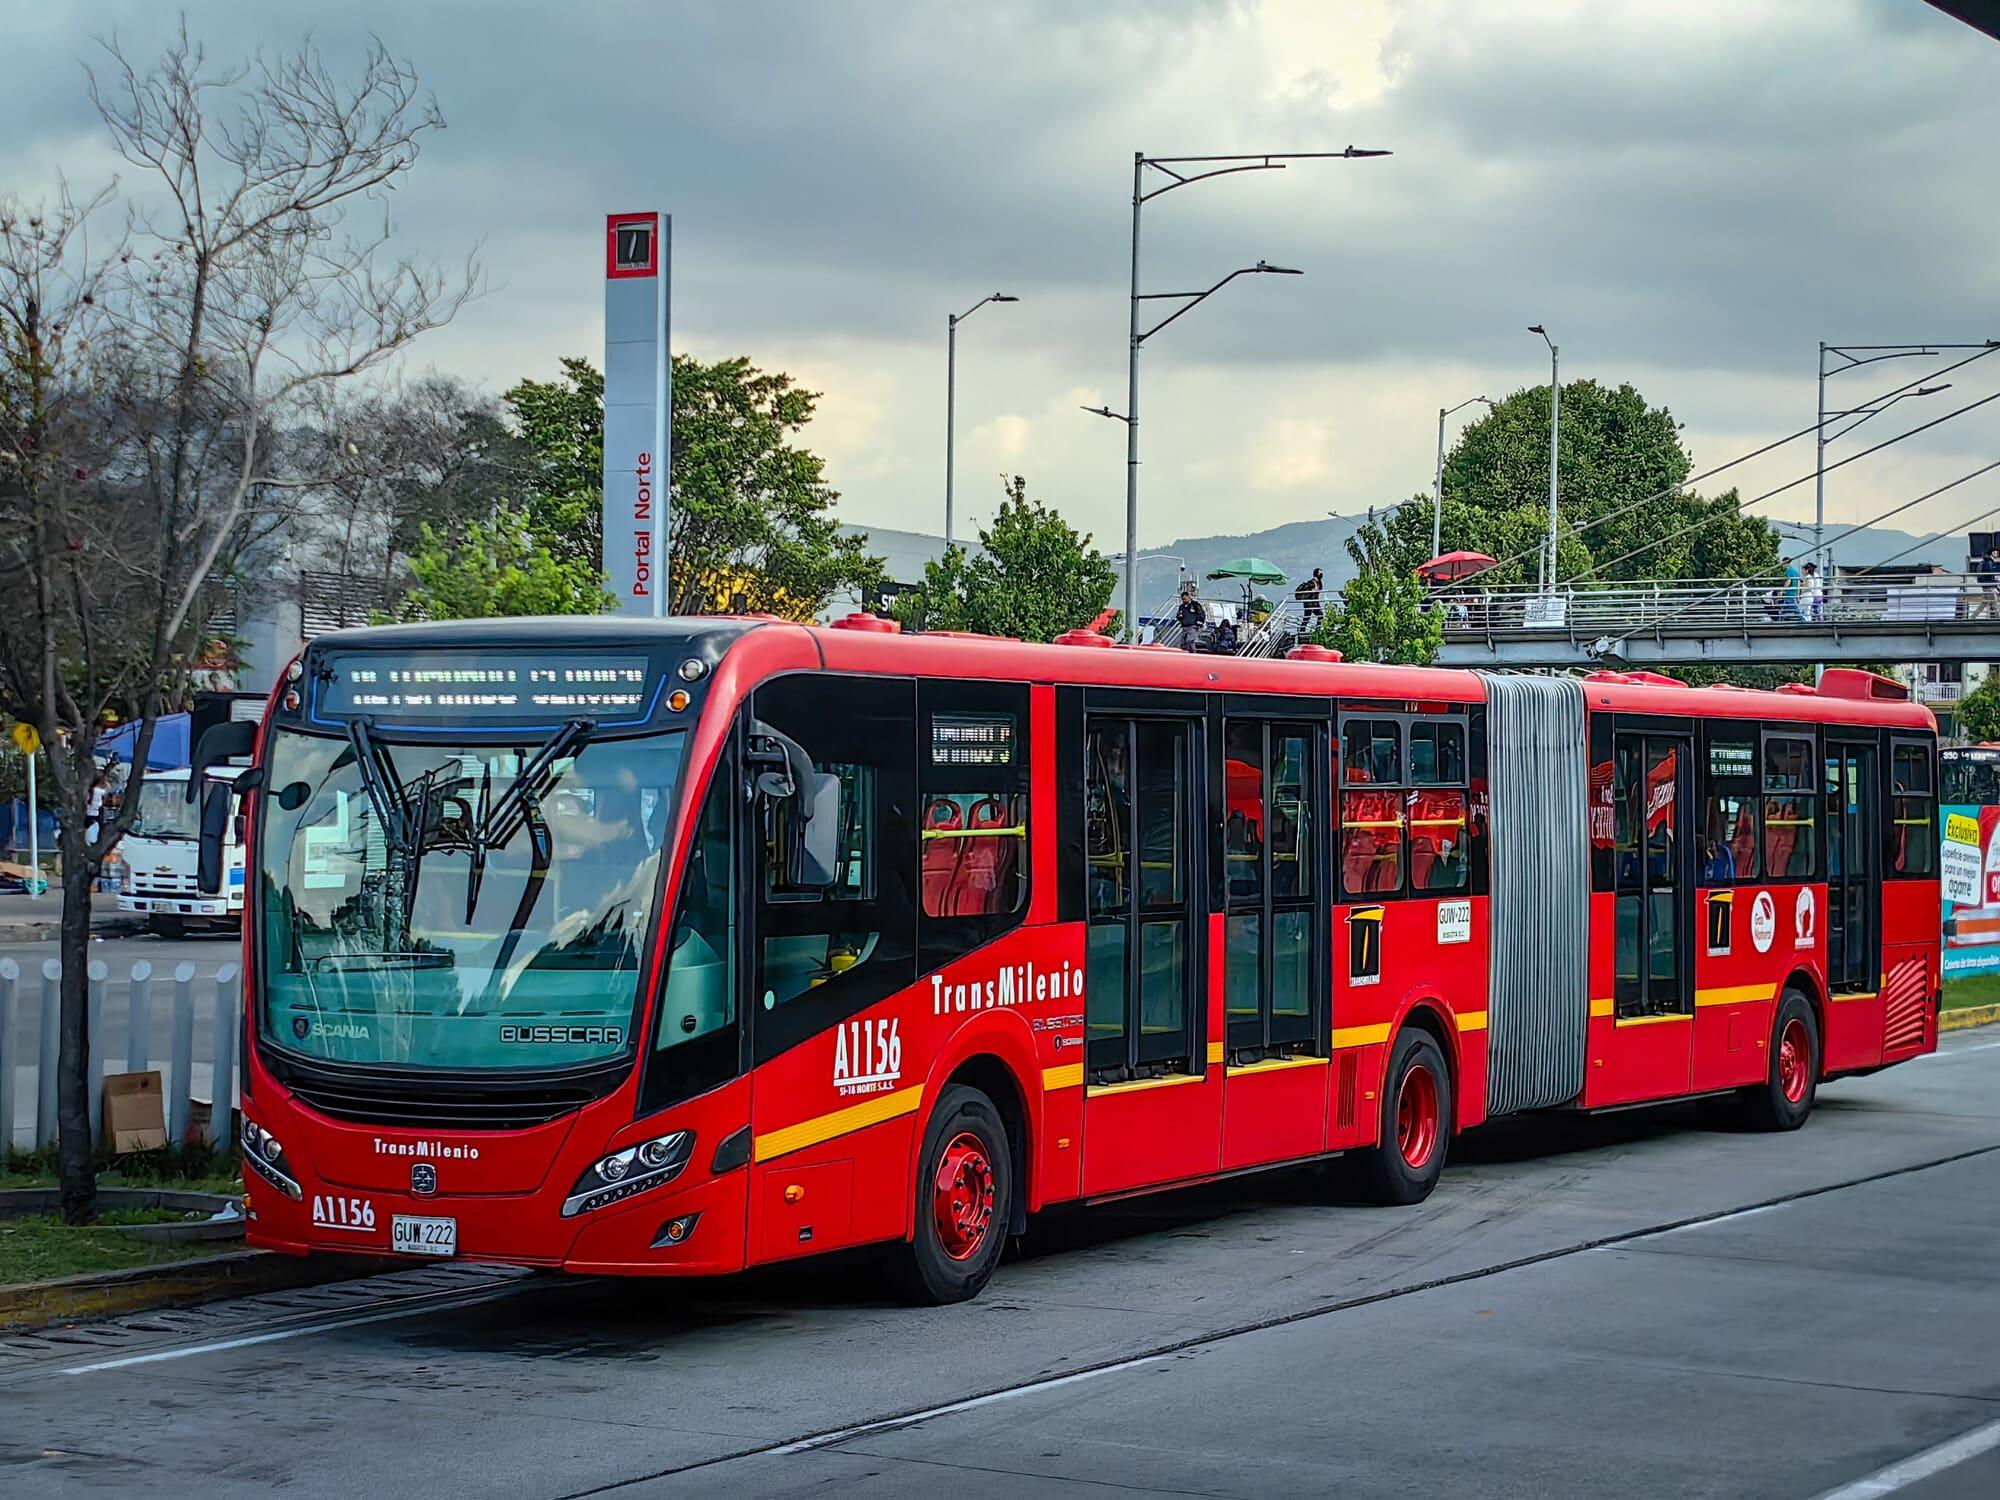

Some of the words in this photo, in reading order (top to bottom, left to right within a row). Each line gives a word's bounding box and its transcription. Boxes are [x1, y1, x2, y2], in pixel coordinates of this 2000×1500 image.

[634, 452, 651, 520] Norte
[633, 531, 650, 596] Portal
[930, 959, 1083, 1016] TransMilenio
[311, 1022, 370, 1040] SCANIA
[499, 1024, 624, 1044] BUSSCAR
[833, 1017, 902, 1080] A1156
[856, 1082, 877, 1095] NORTE
[373, 1138, 480, 1160] TransMilenio
[312, 1195, 376, 1228] A1156
